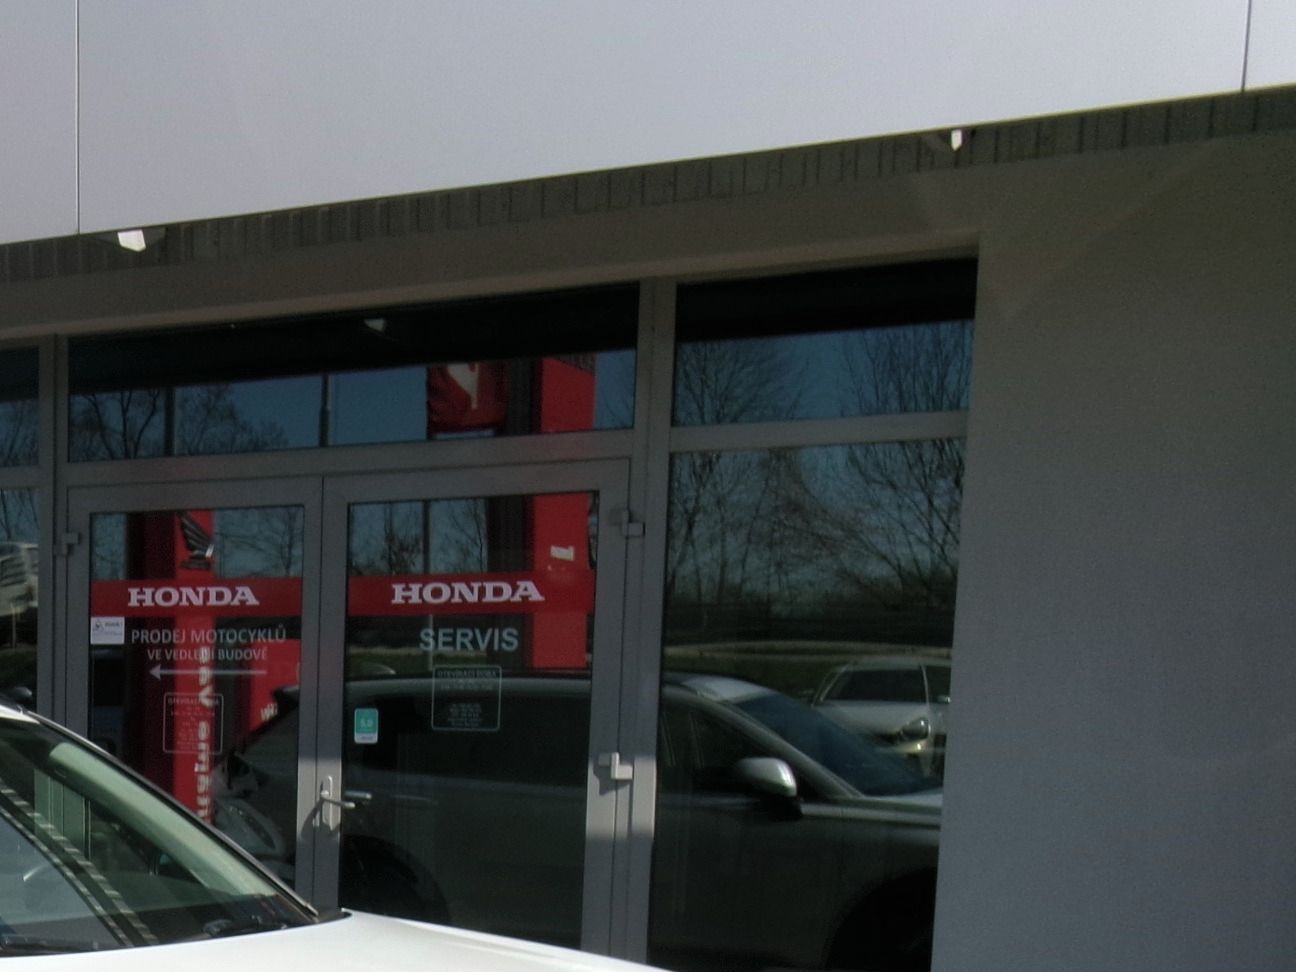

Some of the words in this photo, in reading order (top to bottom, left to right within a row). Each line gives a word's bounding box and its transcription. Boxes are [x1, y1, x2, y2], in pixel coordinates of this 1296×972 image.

[127, 586, 260, 607] HONDA
[391, 580, 545, 604] HONDA
[131, 628, 186, 644] PRODEJ
[190, 623, 287, 644] MOTOCYKLŮ
[419, 627, 519, 651] SERVIS
[147, 649, 162, 661] VE
